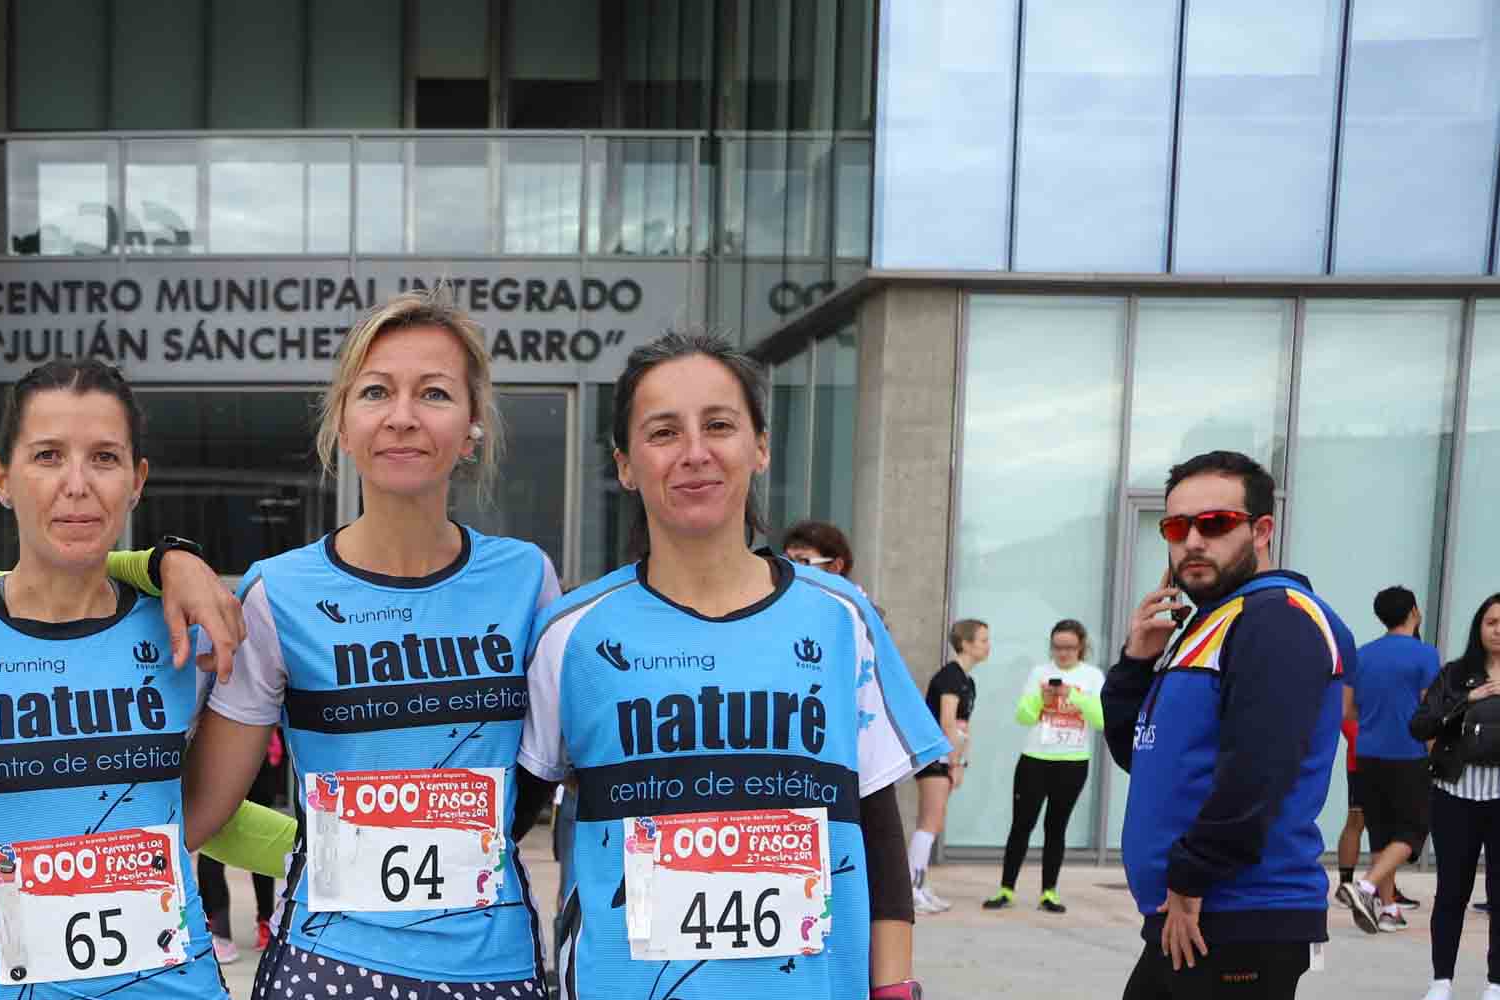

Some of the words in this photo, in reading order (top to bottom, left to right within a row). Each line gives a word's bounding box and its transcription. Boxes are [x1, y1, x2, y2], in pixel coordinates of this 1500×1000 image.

[349, 606, 413, 625] running
[0, 657, 66, 674] running
[333, 623, 514, 686] naturé
[634, 652, 716, 671] running
[323, 699, 399, 722] centro
[407, 695, 441, 714] de
[617, 683, 826, 757] naturé
[53, 753, 87, 773] de
[610, 775, 684, 803] centro
[694, 771, 734, 796] de
[744, 770, 837, 803] estética
[428, 792, 488, 809] PASOS
[750, 833, 812, 852] PASOS
[381, 844, 444, 903] 64
[680, 888, 781, 949] 446
[65, 908, 127, 970] 65
